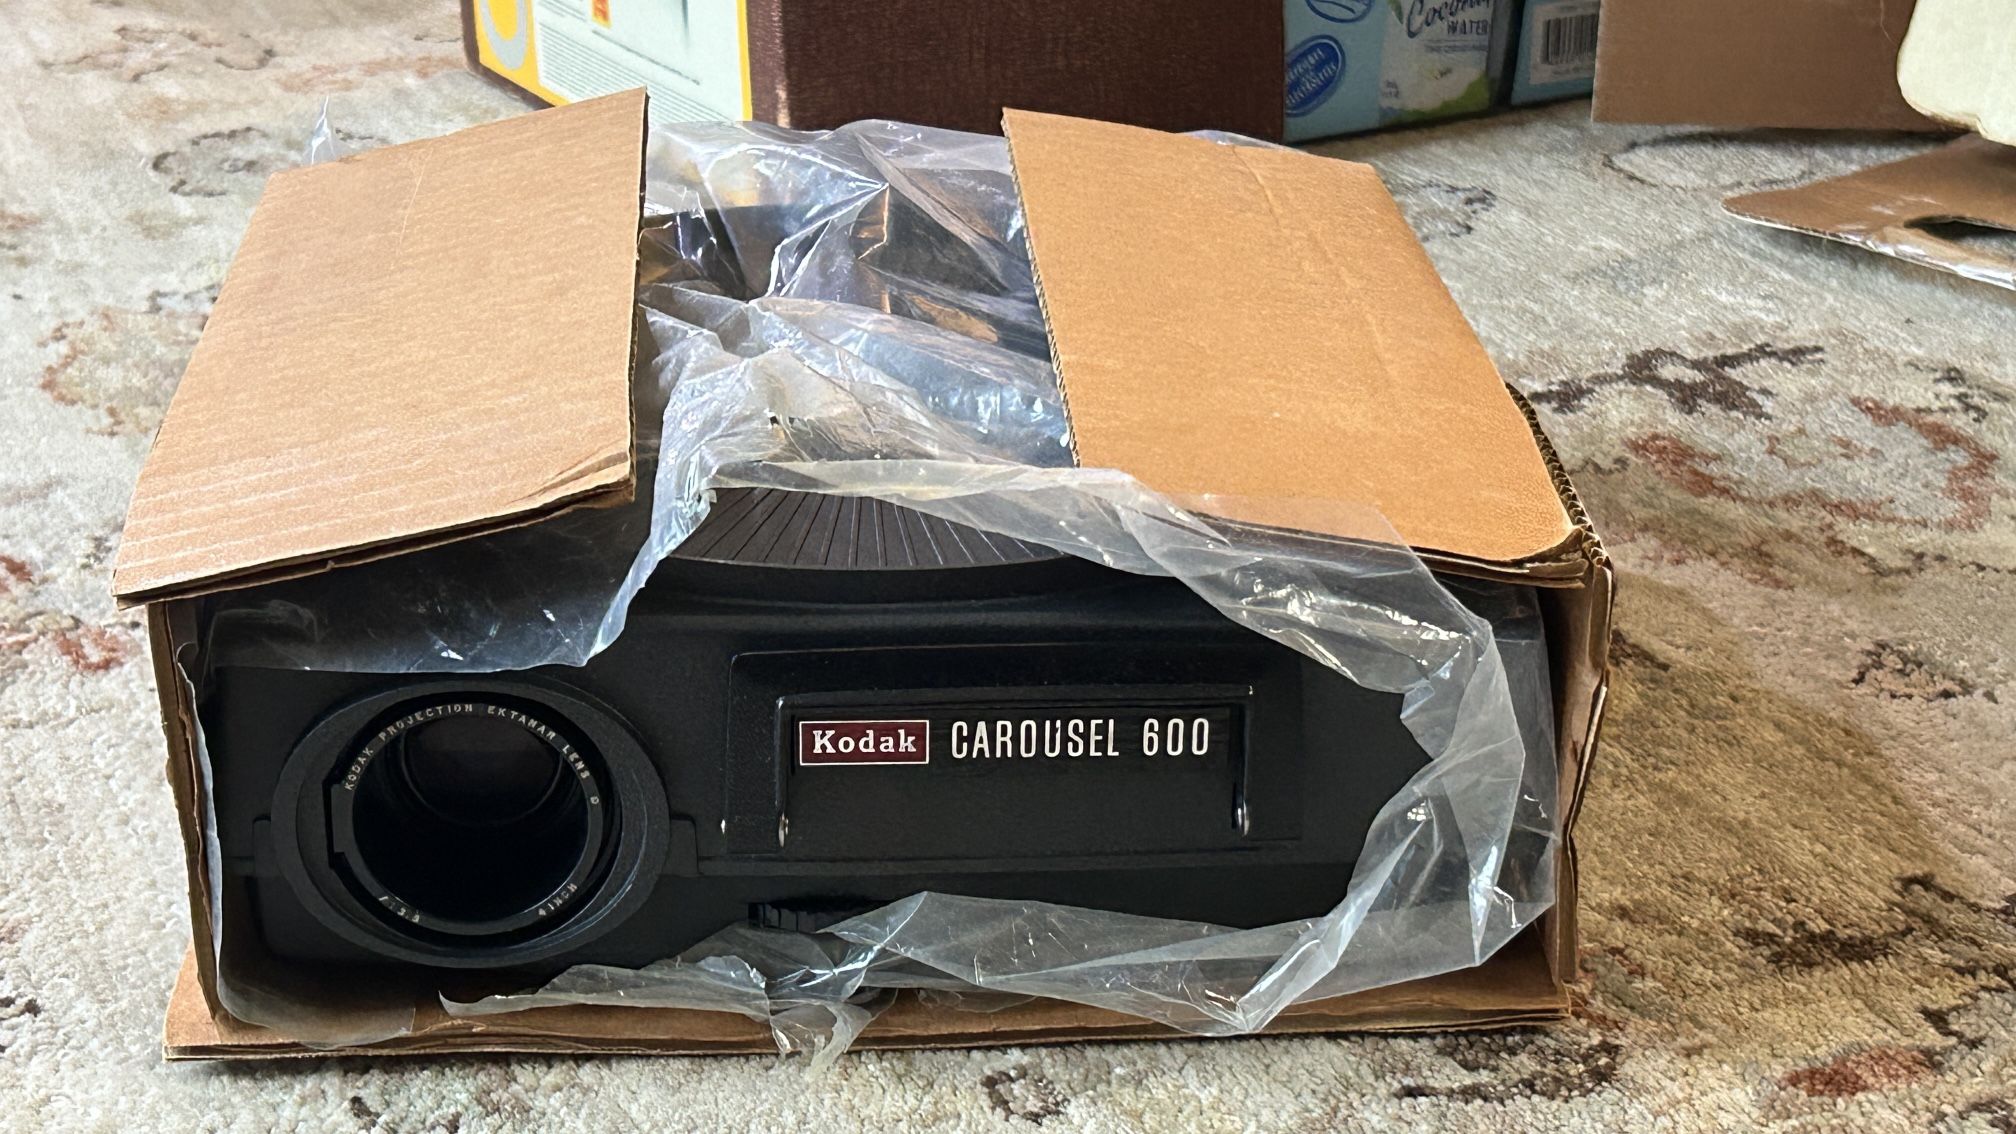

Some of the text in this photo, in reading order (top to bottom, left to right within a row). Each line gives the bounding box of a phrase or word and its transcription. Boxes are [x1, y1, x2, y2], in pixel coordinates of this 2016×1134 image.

[1408, 0, 1490, 39] Coco
[1447, 18, 1489, 36] WATER
[343, 746, 374, 791] KODAK
[379, 702, 474, 742] PROJECTION
[486, 704, 558, 741] EKTANAR
[561, 743, 591, 781] LENS
[812, 716, 1210, 759] Kodak CAROUSEL 600
